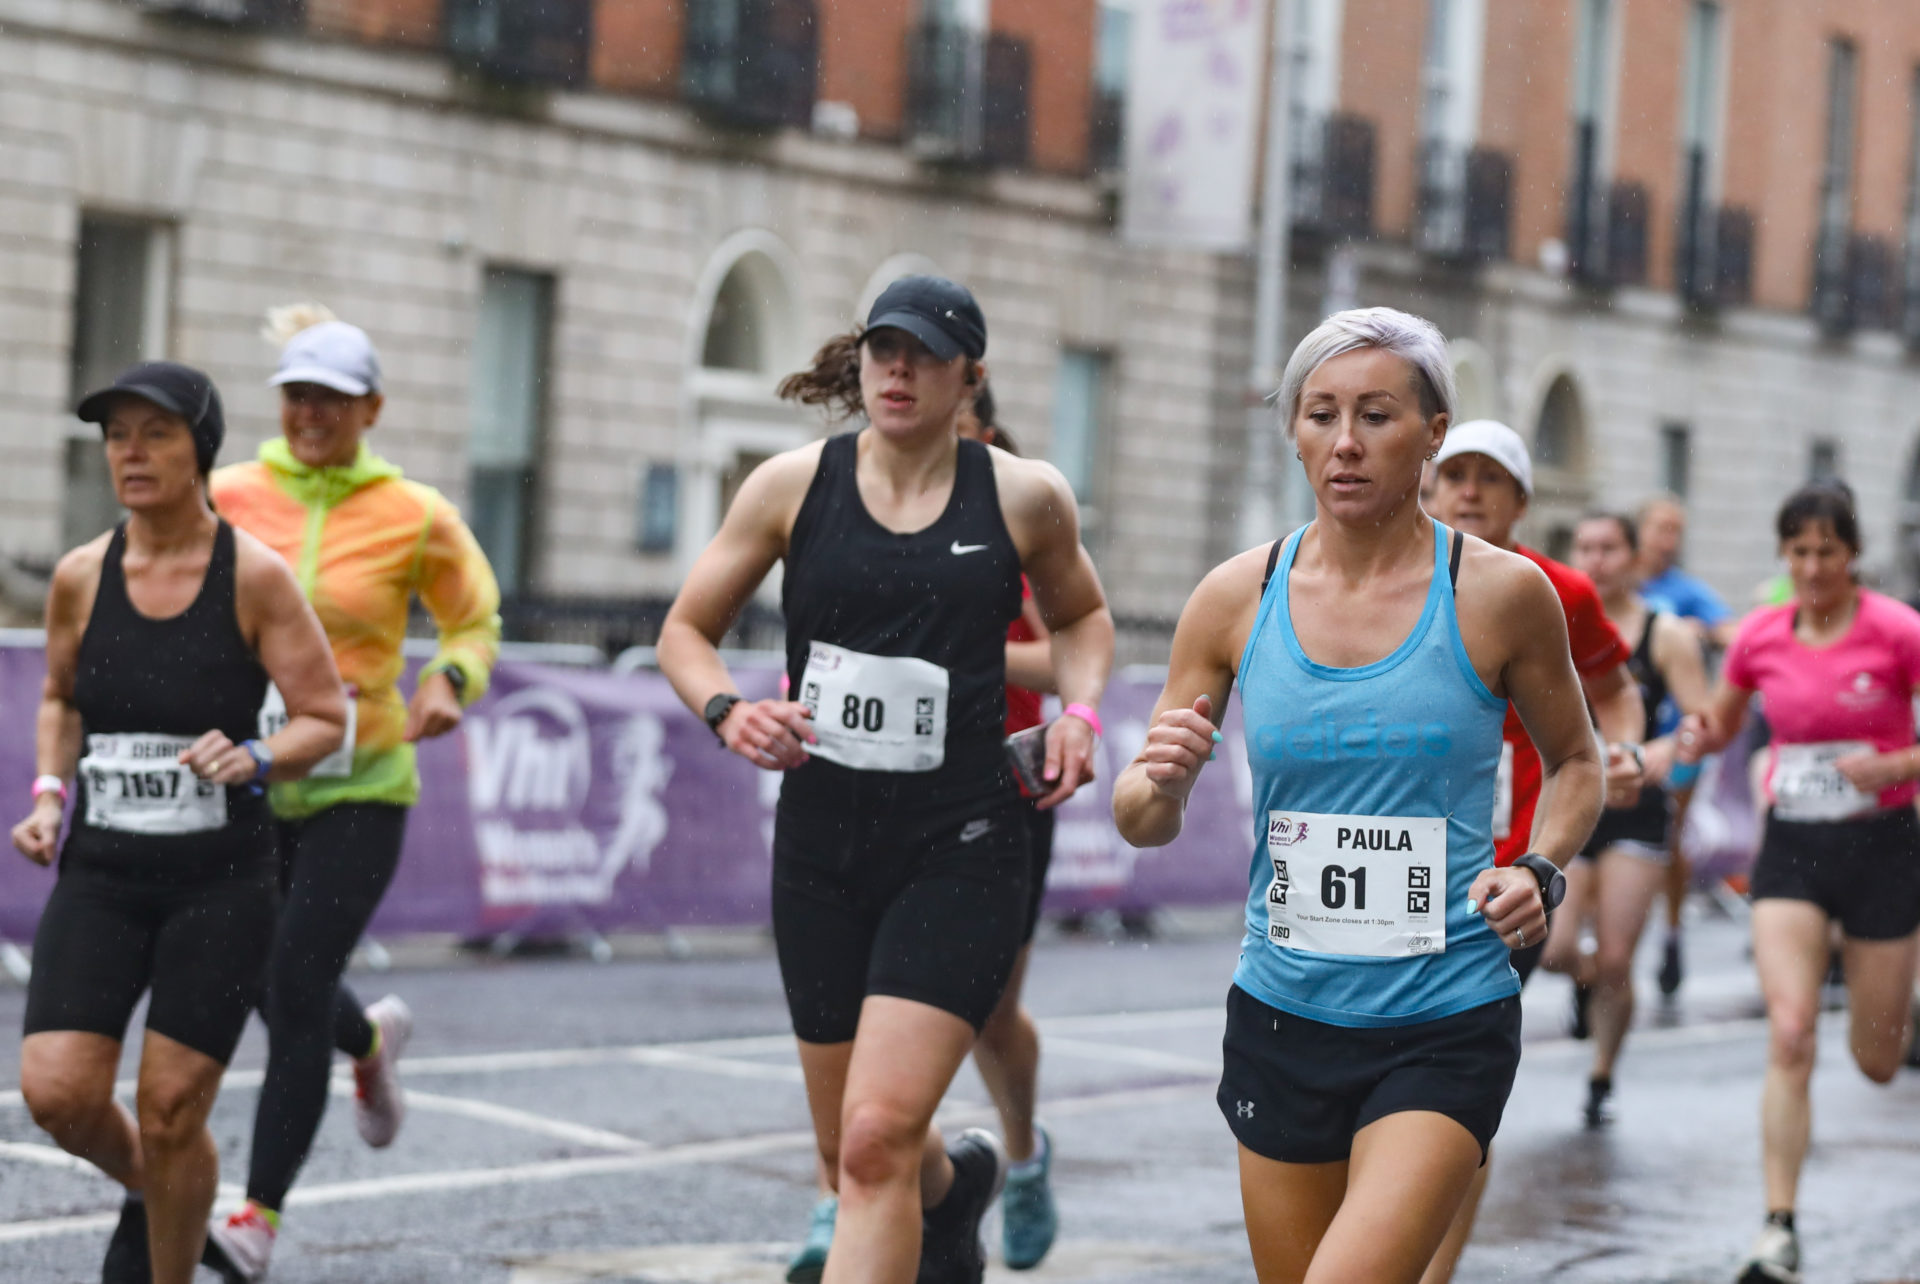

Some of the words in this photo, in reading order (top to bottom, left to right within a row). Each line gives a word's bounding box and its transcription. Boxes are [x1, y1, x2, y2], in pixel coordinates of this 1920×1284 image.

[842, 693, 885, 732] 80
[1256, 708, 1451, 761] adidas
[1270, 820, 1290, 834] Vhi
[1337, 827, 1413, 851] PAULA
[1321, 864, 1366, 910] 61
[1271, 925, 1290, 938] DSD
